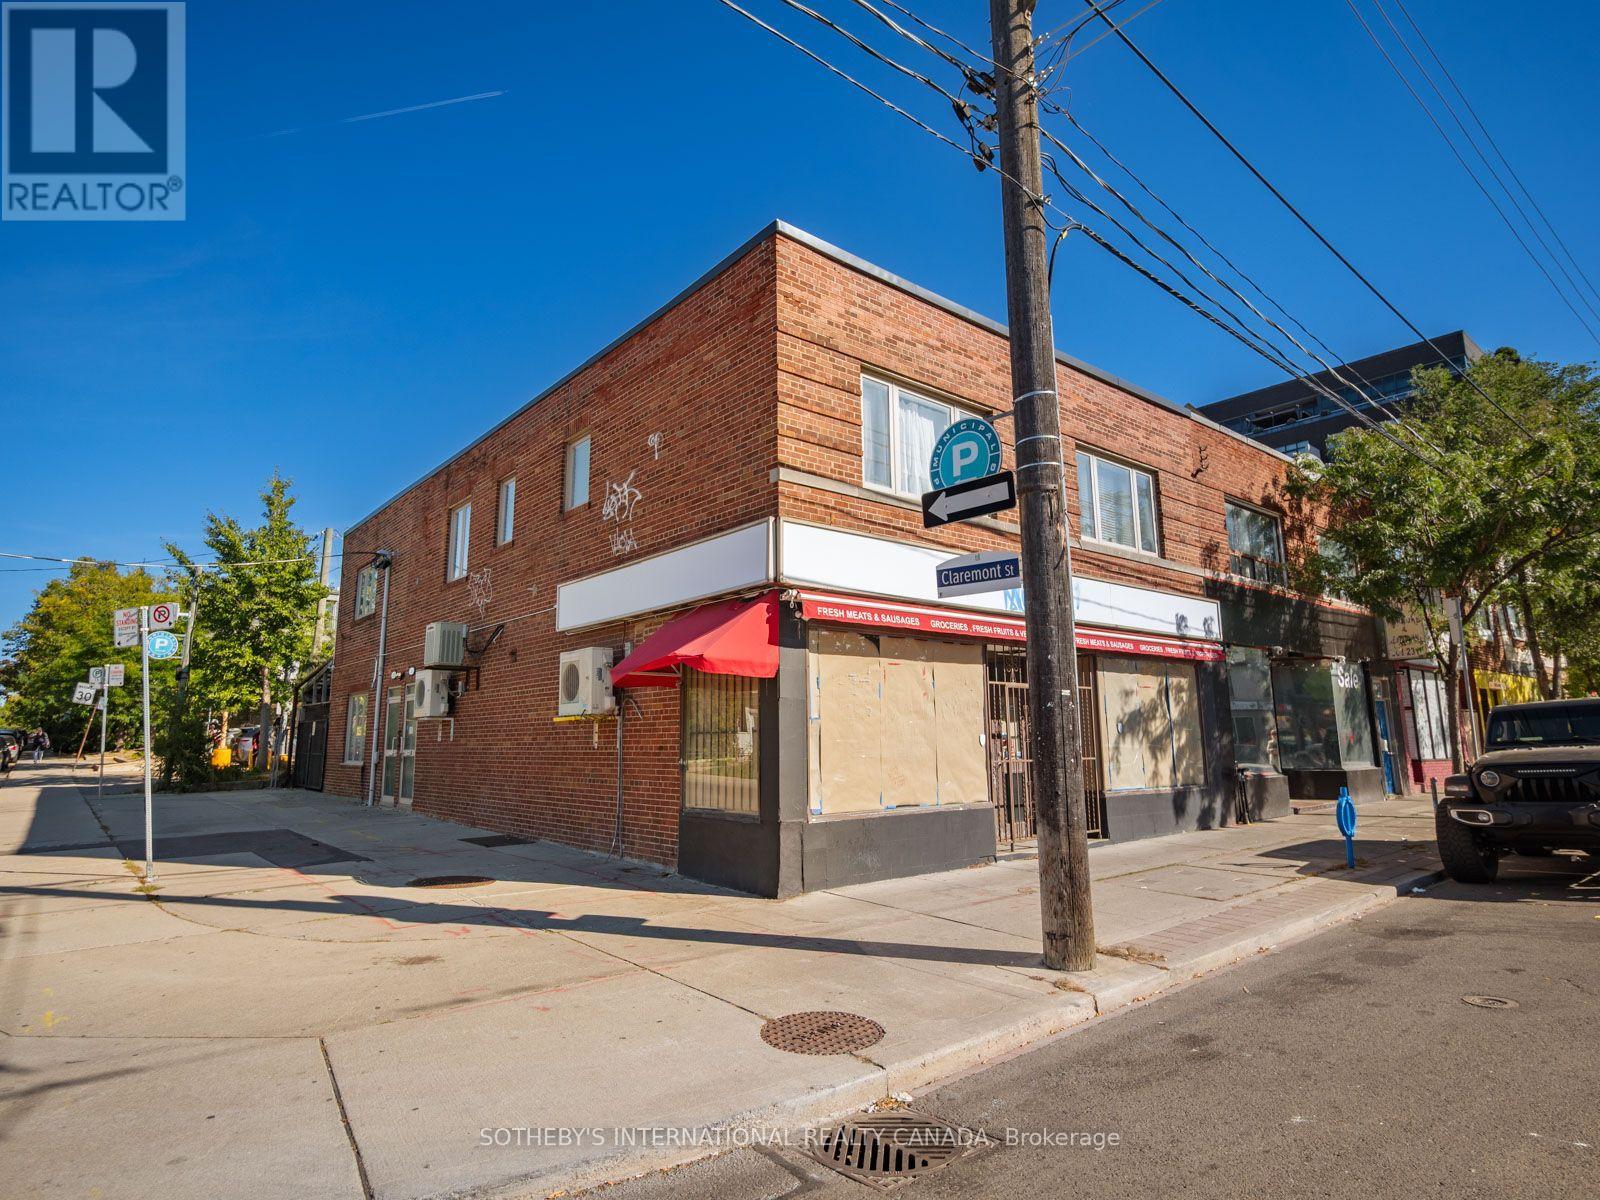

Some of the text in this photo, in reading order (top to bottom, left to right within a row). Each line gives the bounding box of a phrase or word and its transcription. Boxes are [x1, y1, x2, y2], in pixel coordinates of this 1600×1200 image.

[932, 422, 997, 467] MUNICIPAL
[952, 440, 979, 477] P
[941, 563, 1014, 586] Claremont St
[817, 606, 845, 618] FRESH
[846, 609, 872, 621] MEATS
[873, 613, 880, 622] &
[881, 613, 920, 626] SAUSAGES
[930, 619, 968, 632] GROCERIES
[972, 624, 993, 635] FRESH
[993, 626, 1014, 637] FRUITS
[1090, 638, 1106, 647] MEATS
[1337, 666, 1359, 689] Sale
[76, 691, 92, 702] 30
